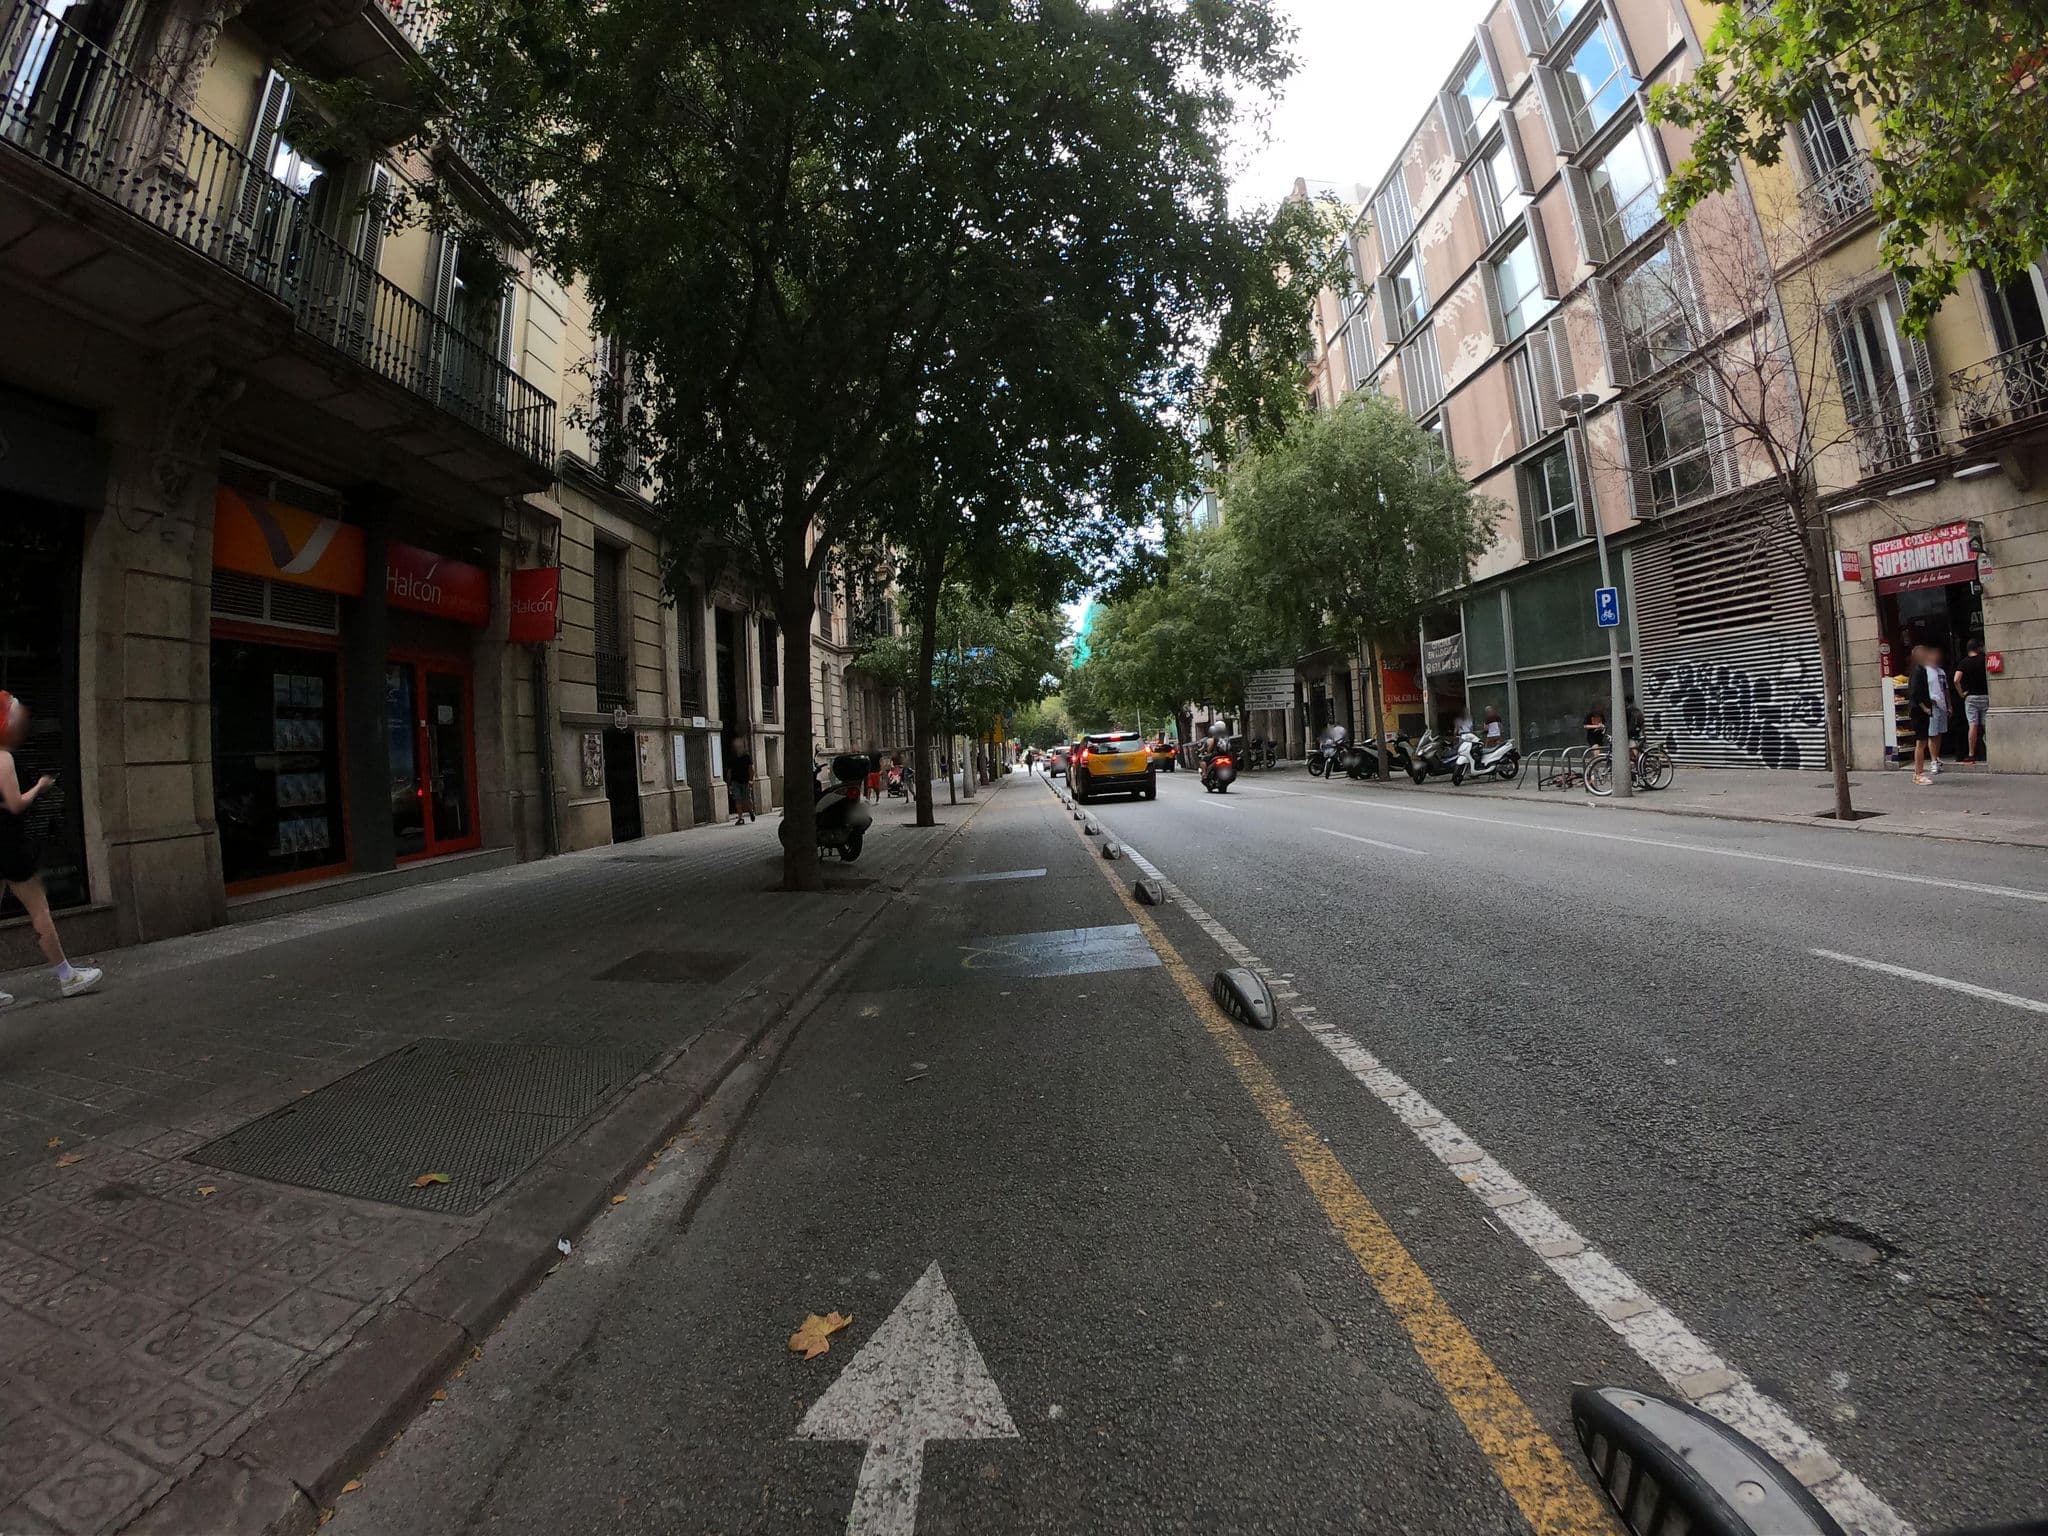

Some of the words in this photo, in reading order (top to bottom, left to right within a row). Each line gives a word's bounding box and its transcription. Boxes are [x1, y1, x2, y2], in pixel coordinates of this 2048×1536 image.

[1841, 552, 1858, 562] SUPER
[1873, 539, 1903, 554] SUPER
[1875, 538, 1971, 578] SUPERMERCAT
[385, 562, 441, 606] Halcón
[512, 587, 553, 615] Halcón
[1601, 593, 1612, 608] P
